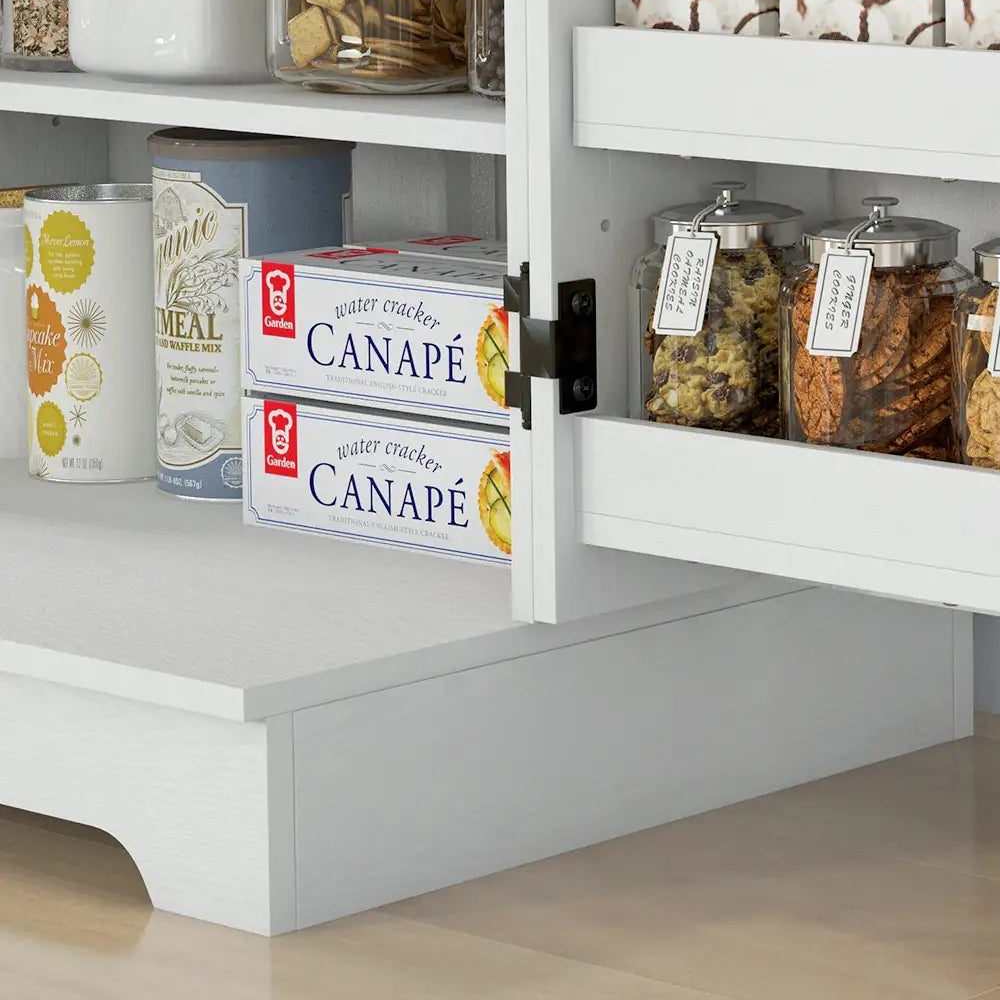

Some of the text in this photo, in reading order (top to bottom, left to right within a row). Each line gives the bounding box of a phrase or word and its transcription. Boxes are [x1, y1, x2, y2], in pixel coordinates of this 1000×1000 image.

[63, 234, 89, 247] Lemon
[664, 253, 682, 312] COOKIES
[676, 249, 694, 314] OATMEAL
[689, 257, 705, 308] RAISIN
[825, 269, 843, 331] COOKIES
[839, 274, 857, 329] GINGER
[264, 315, 294, 330] Garden
[334, 297, 440, 331] water cracker
[170, 341, 200, 353] WAFFLE
[201, 344, 222, 353] MIX
[306, 322, 467, 385] CANAPÉ
[266, 454, 296, 470] Garden
[336, 437, 443, 474] water cracker
[308, 462, 469, 529] CANAPÉ
